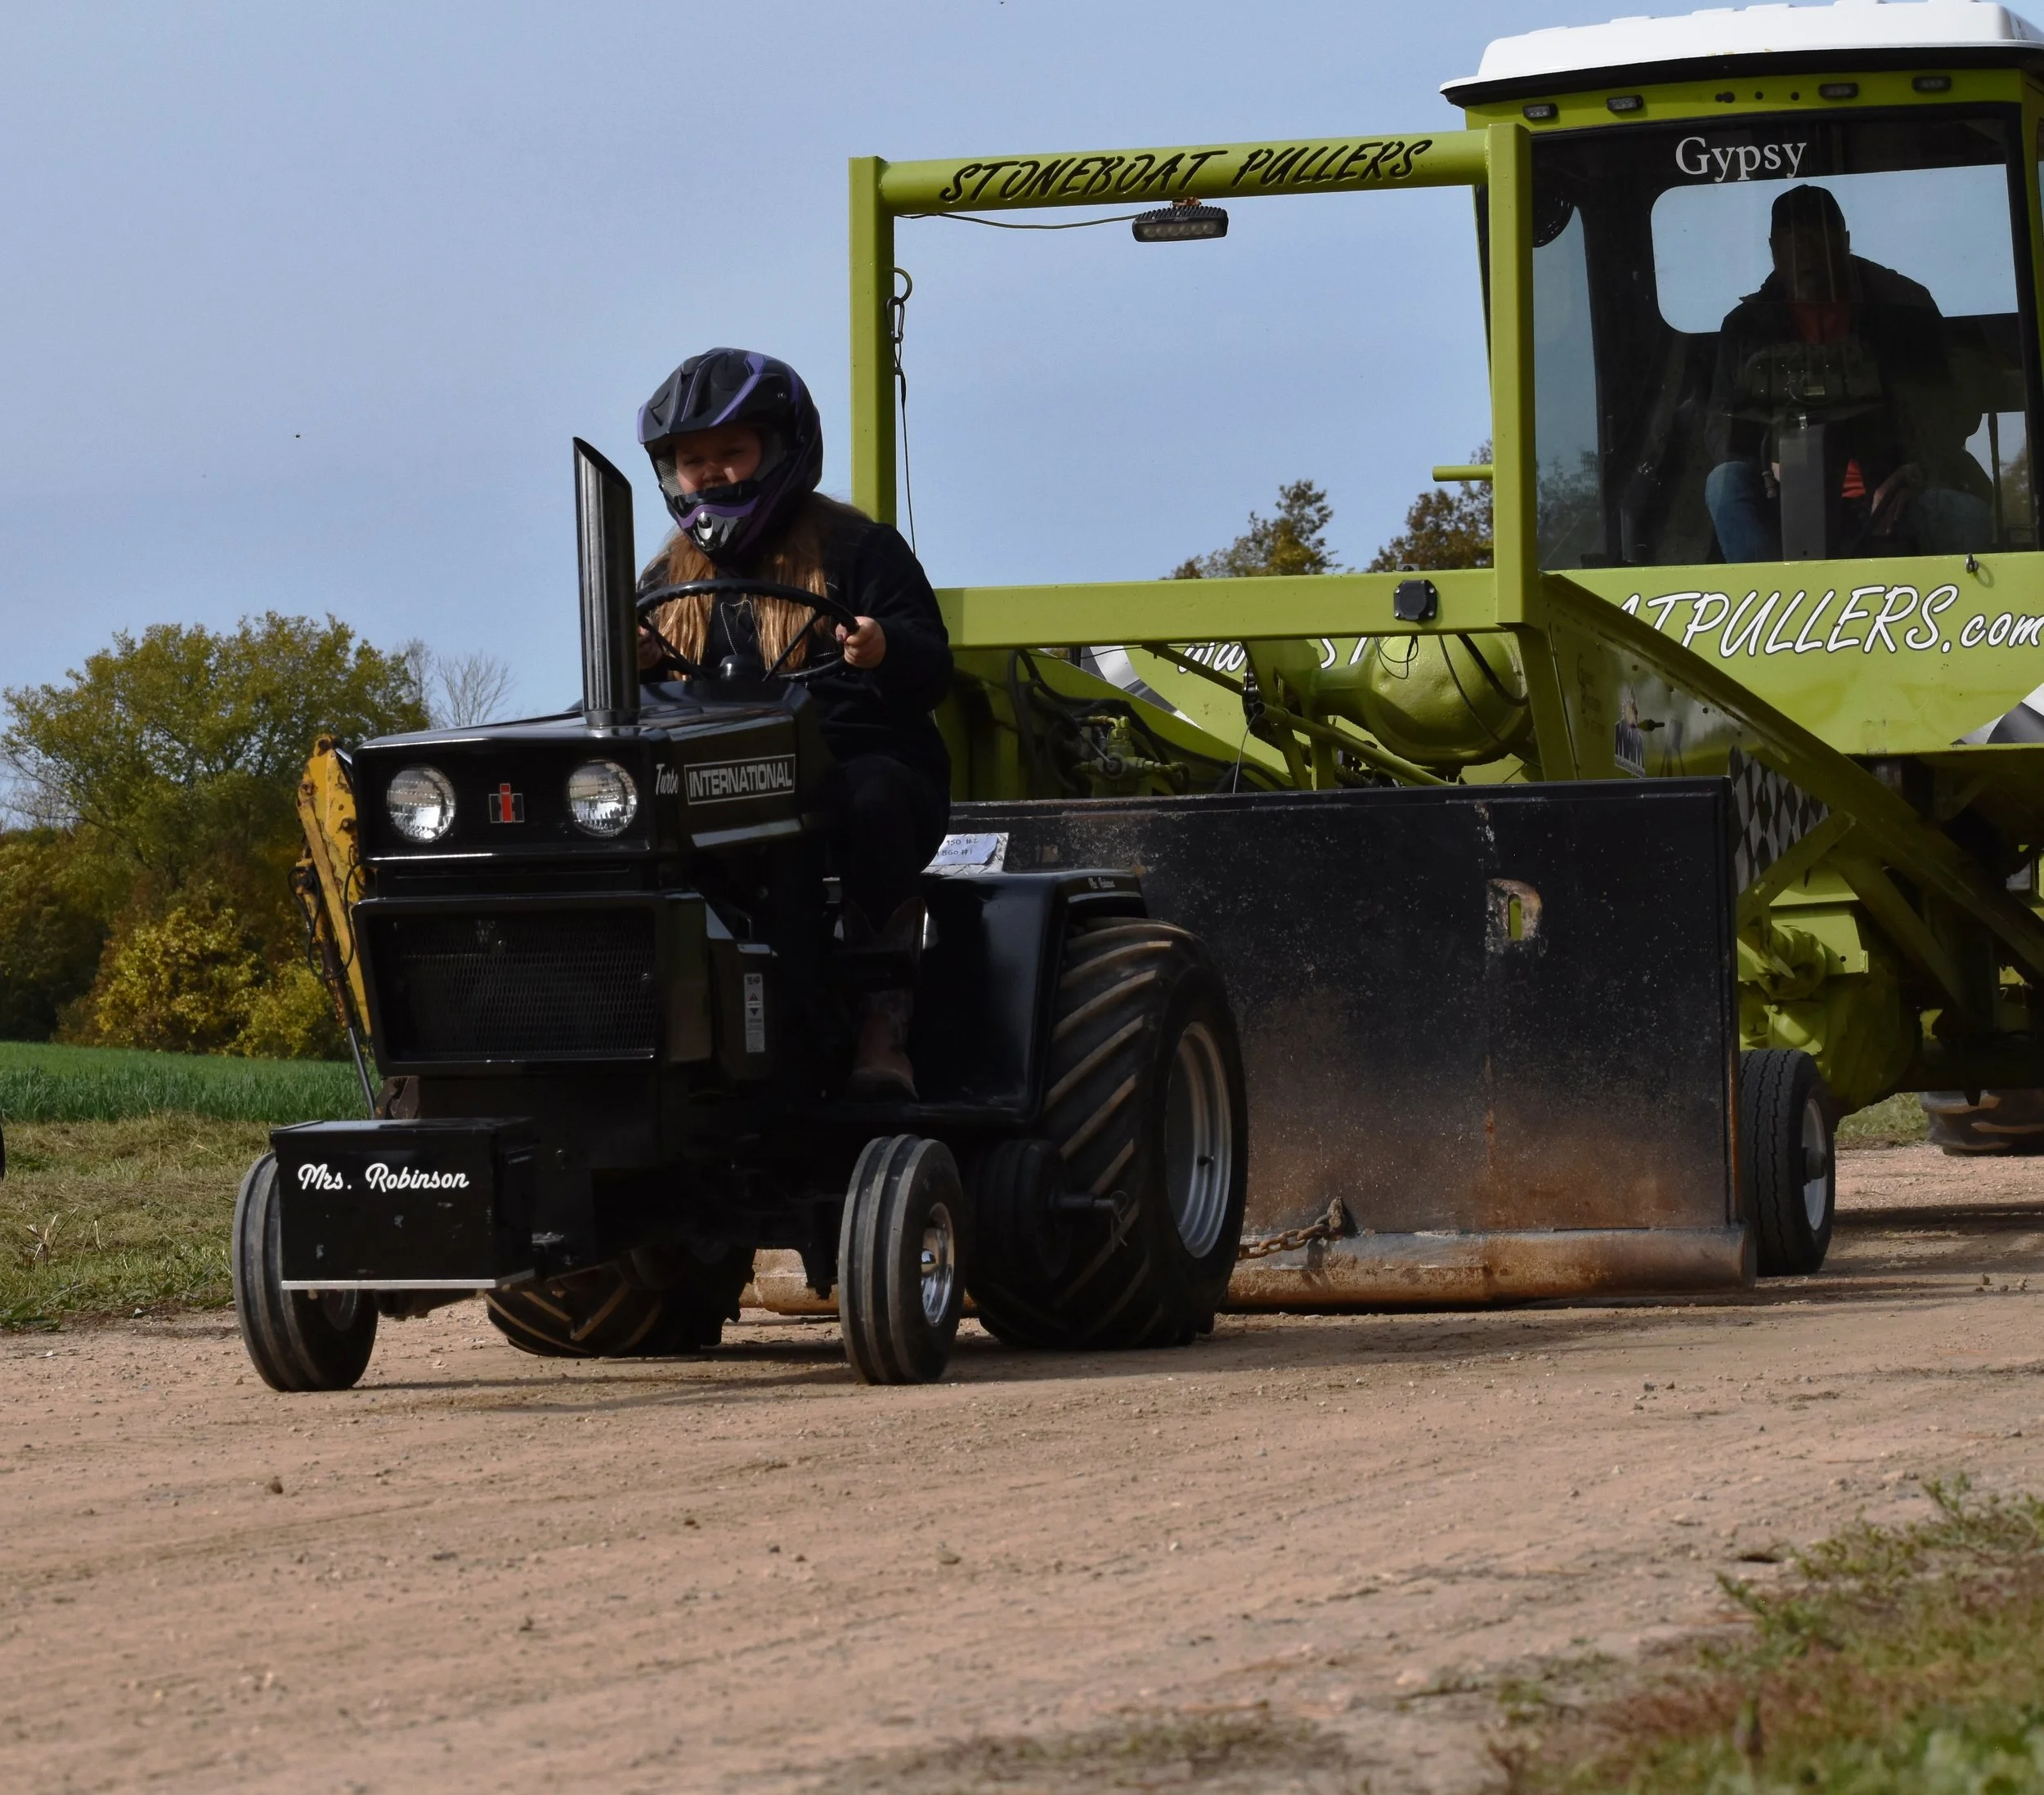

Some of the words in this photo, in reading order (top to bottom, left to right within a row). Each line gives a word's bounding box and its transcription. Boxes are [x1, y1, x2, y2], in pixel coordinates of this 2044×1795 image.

[939, 150, 1229, 204] STONEBOAT
[1230, 139, 1433, 188] PULLERS
[1675, 137, 1807, 183] Gypsy
[656, 763, 679, 795] Turbo
[688, 761, 793, 798] INTERNATIONAL
[297, 1163, 353, 1190] Mrs.
[365, 1162, 470, 1193] Robinson
